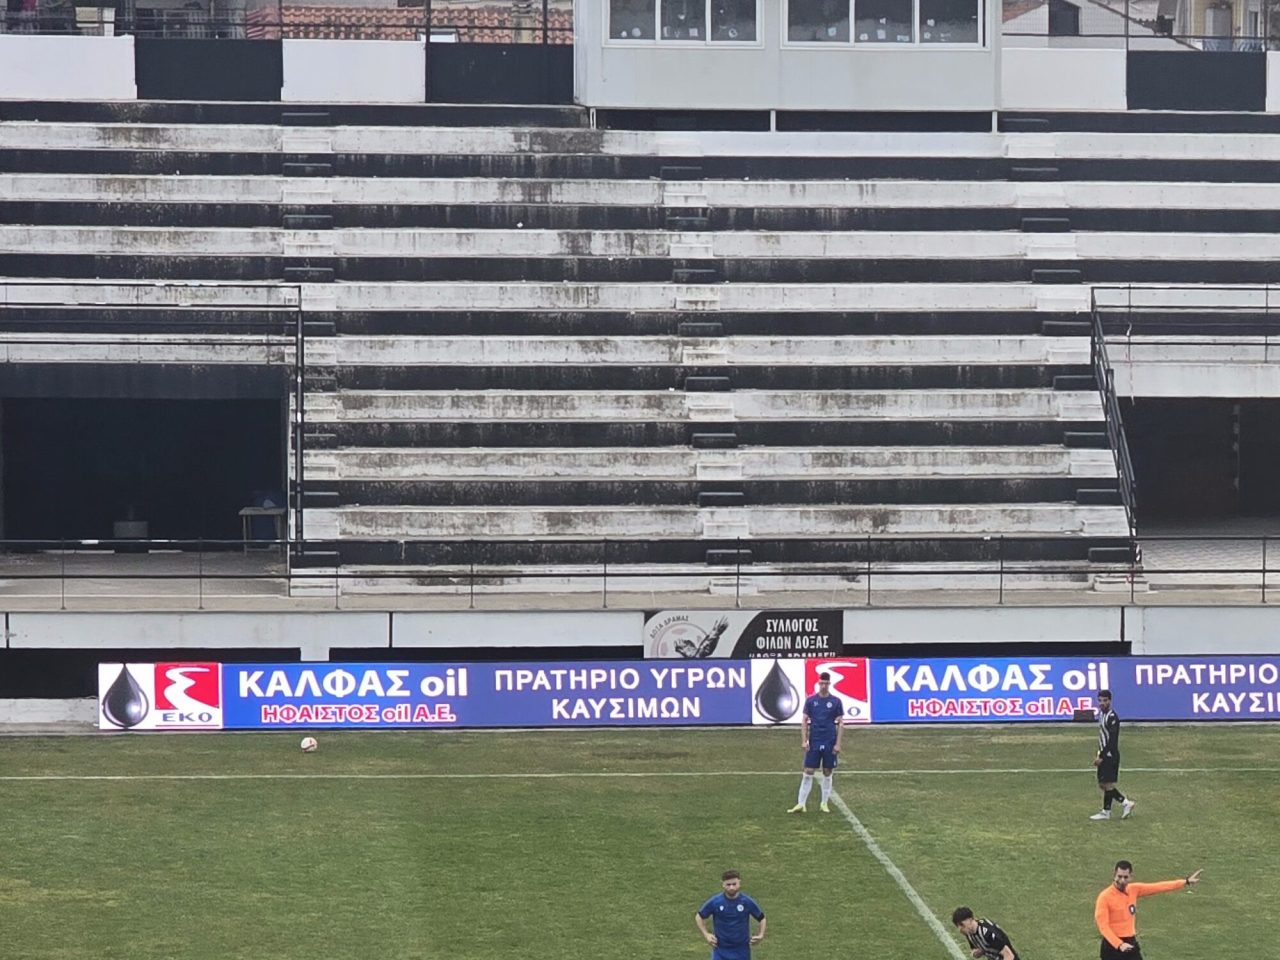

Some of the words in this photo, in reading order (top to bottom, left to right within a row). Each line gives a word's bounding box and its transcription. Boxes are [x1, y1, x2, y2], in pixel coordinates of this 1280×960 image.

[766, 618, 819, 633] ΣΥΛΛΟΓΟΣ
[756, 635, 791, 650] ΦΙΛΩΝ
[795, 635, 829, 649] ΔΟΞΑΣ
[238, 669, 411, 698] ΚΑΛΦΑΣ
[420, 668, 468, 697] oil
[495, 669, 640, 691] ΠΡΑΤΗΡΙΟ
[650, 667, 747, 689] ΥΓΡΩΝ
[886, 664, 1054, 692] ΚΑΛΦΑΣ
[1062, 662, 1109, 691] oil
[1135, 664, 1279, 685] ΠΡΑΤΗΡΙΟ
[262, 705, 379, 722] ΗΦΑΙΣΤΟΣ
[384, 705, 410, 722] oil
[414, 704, 456, 722] Α.Ε.
[552, 697, 700, 719] ΚΑΥΣΙΜΩΝ
[909, 698, 1023, 717] ΗΦΑΙΣΤΟΣ
[1026, 697, 1054, 715] oil
